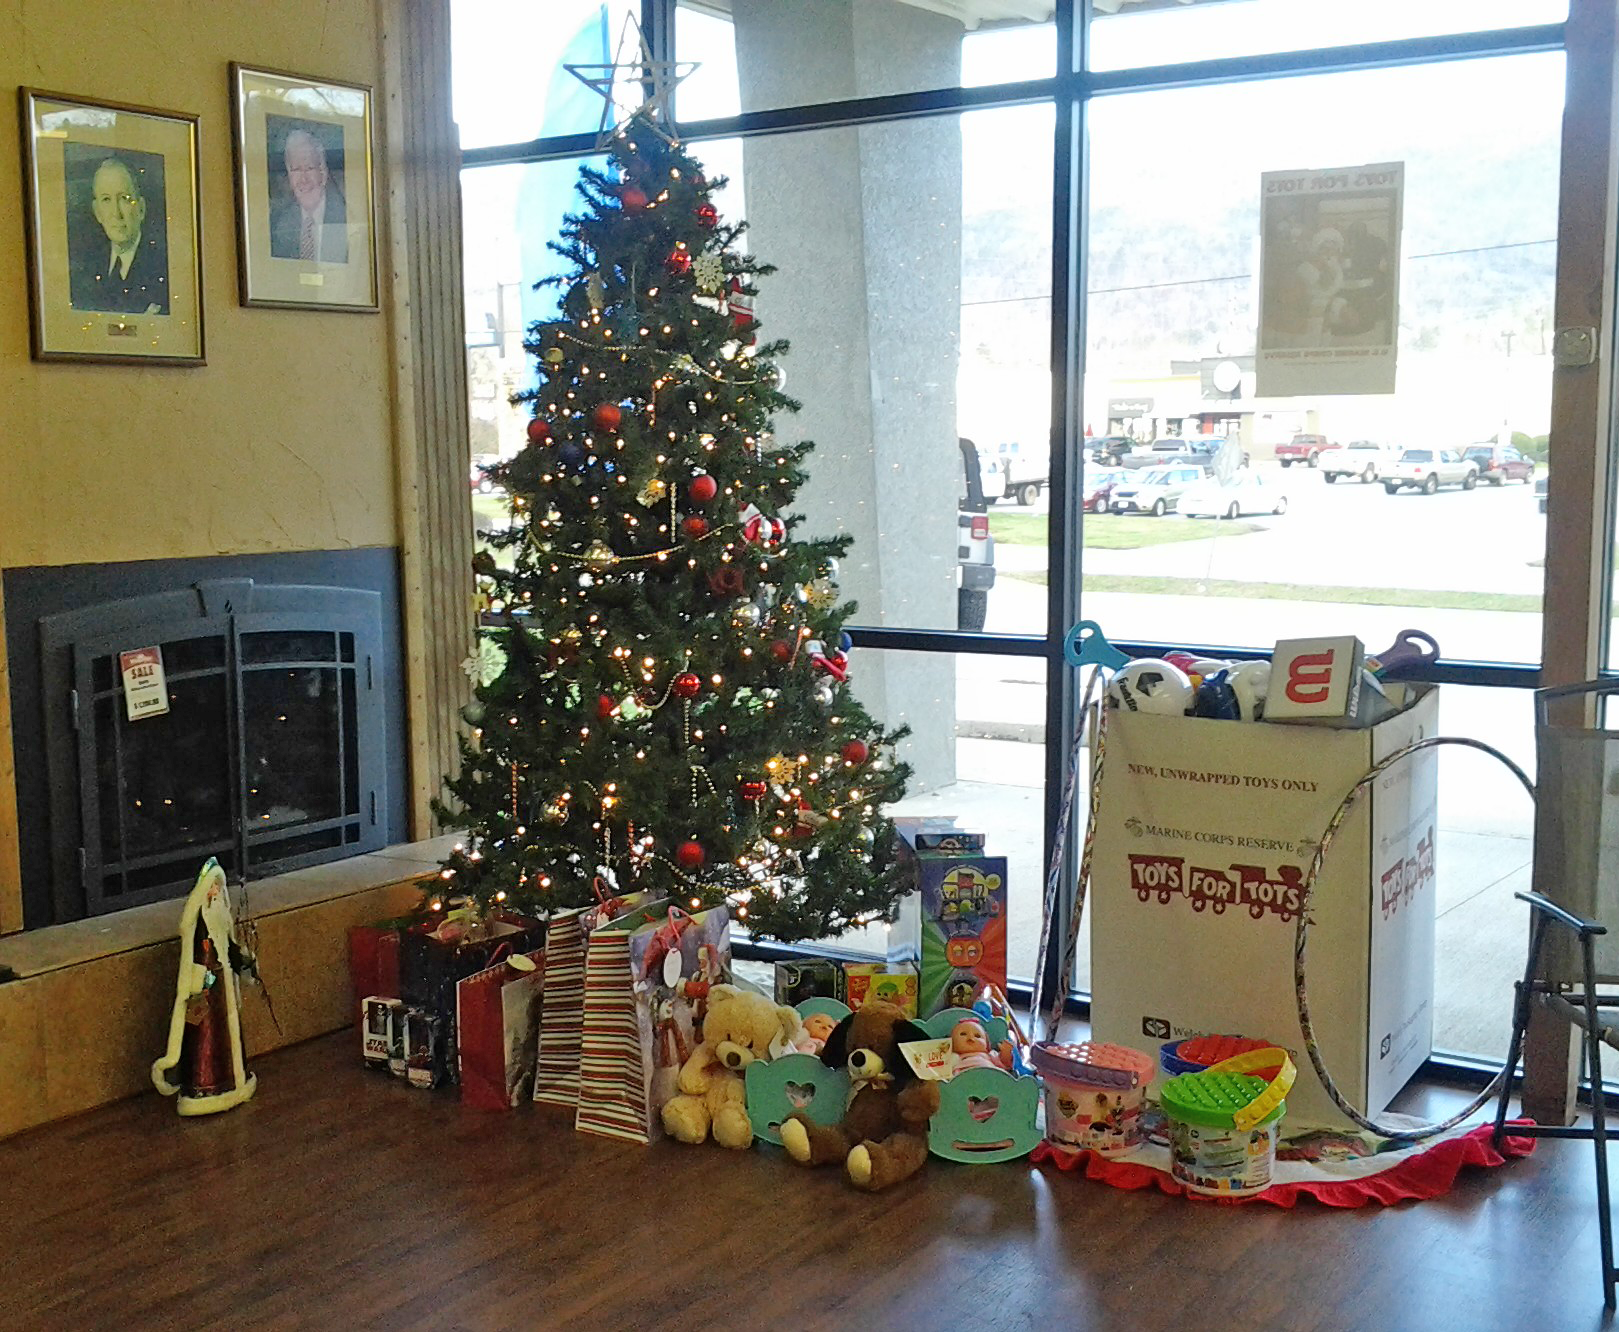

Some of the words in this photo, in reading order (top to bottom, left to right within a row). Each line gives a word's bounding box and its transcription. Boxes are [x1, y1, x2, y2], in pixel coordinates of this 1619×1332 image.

[1127, 763, 1158, 778] NEW,
[1160, 767, 1241, 787] UNWRAPPED
[1243, 775, 1279, 790] TOYS
[1281, 779, 1319, 793] ONLY
[1145, 825, 1193, 841] MARINE
[1194, 831, 1235, 847] CORPS
[1237, 837, 1295, 852] RESERVE
[1133, 861, 1180, 889] TOYS
[1190, 871, 1232, 901] FOR
[1243, 881, 1300, 911] TOTS
